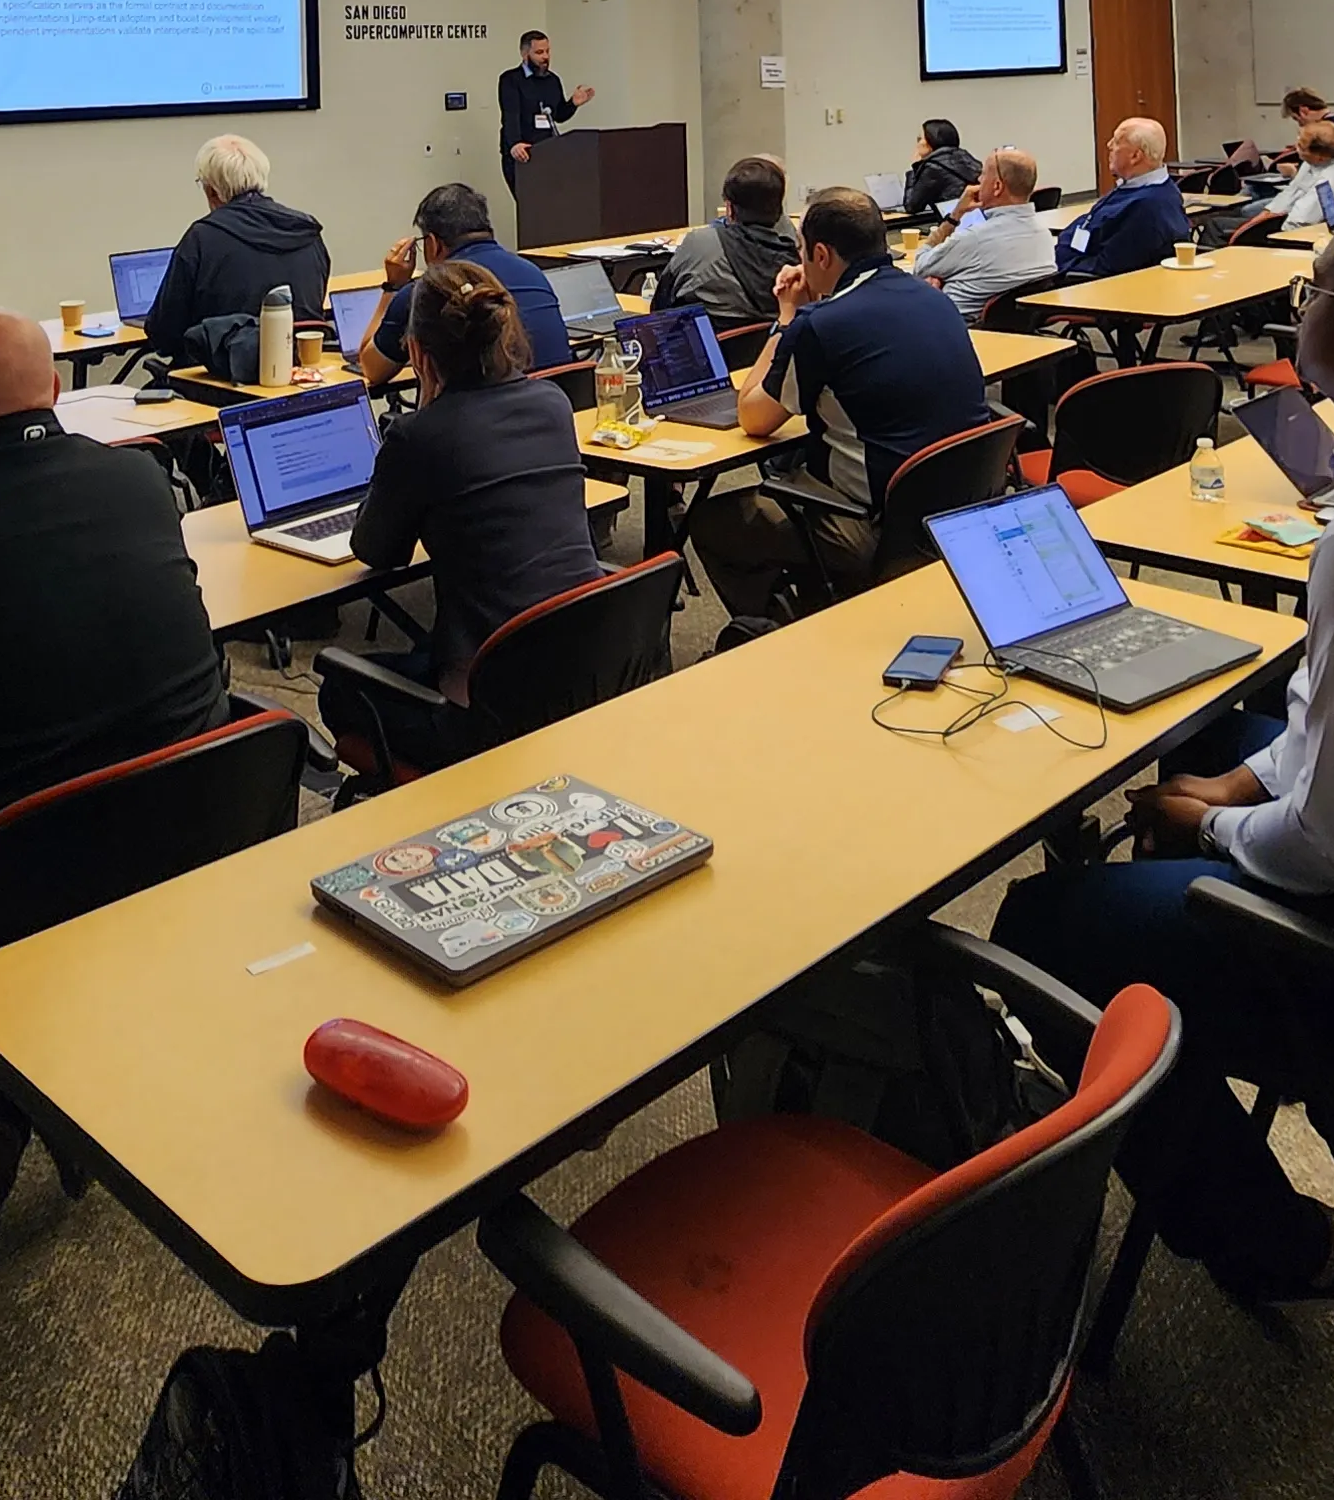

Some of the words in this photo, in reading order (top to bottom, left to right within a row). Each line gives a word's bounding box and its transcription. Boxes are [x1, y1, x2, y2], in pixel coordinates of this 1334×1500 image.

[3, 0, 61, 11] specification
[109, 2, 123, 10] the
[345, 5, 369, 20] SAN
[373, 5, 406, 20] DIEGO
[72, 14, 117, 24] jump-start
[159, 14, 174, 23] and
[346, 25, 443, 40] SUPERCOMPUTER
[447, 25, 487, 38] CENTER
[409, 858, 515, 905] DATA
